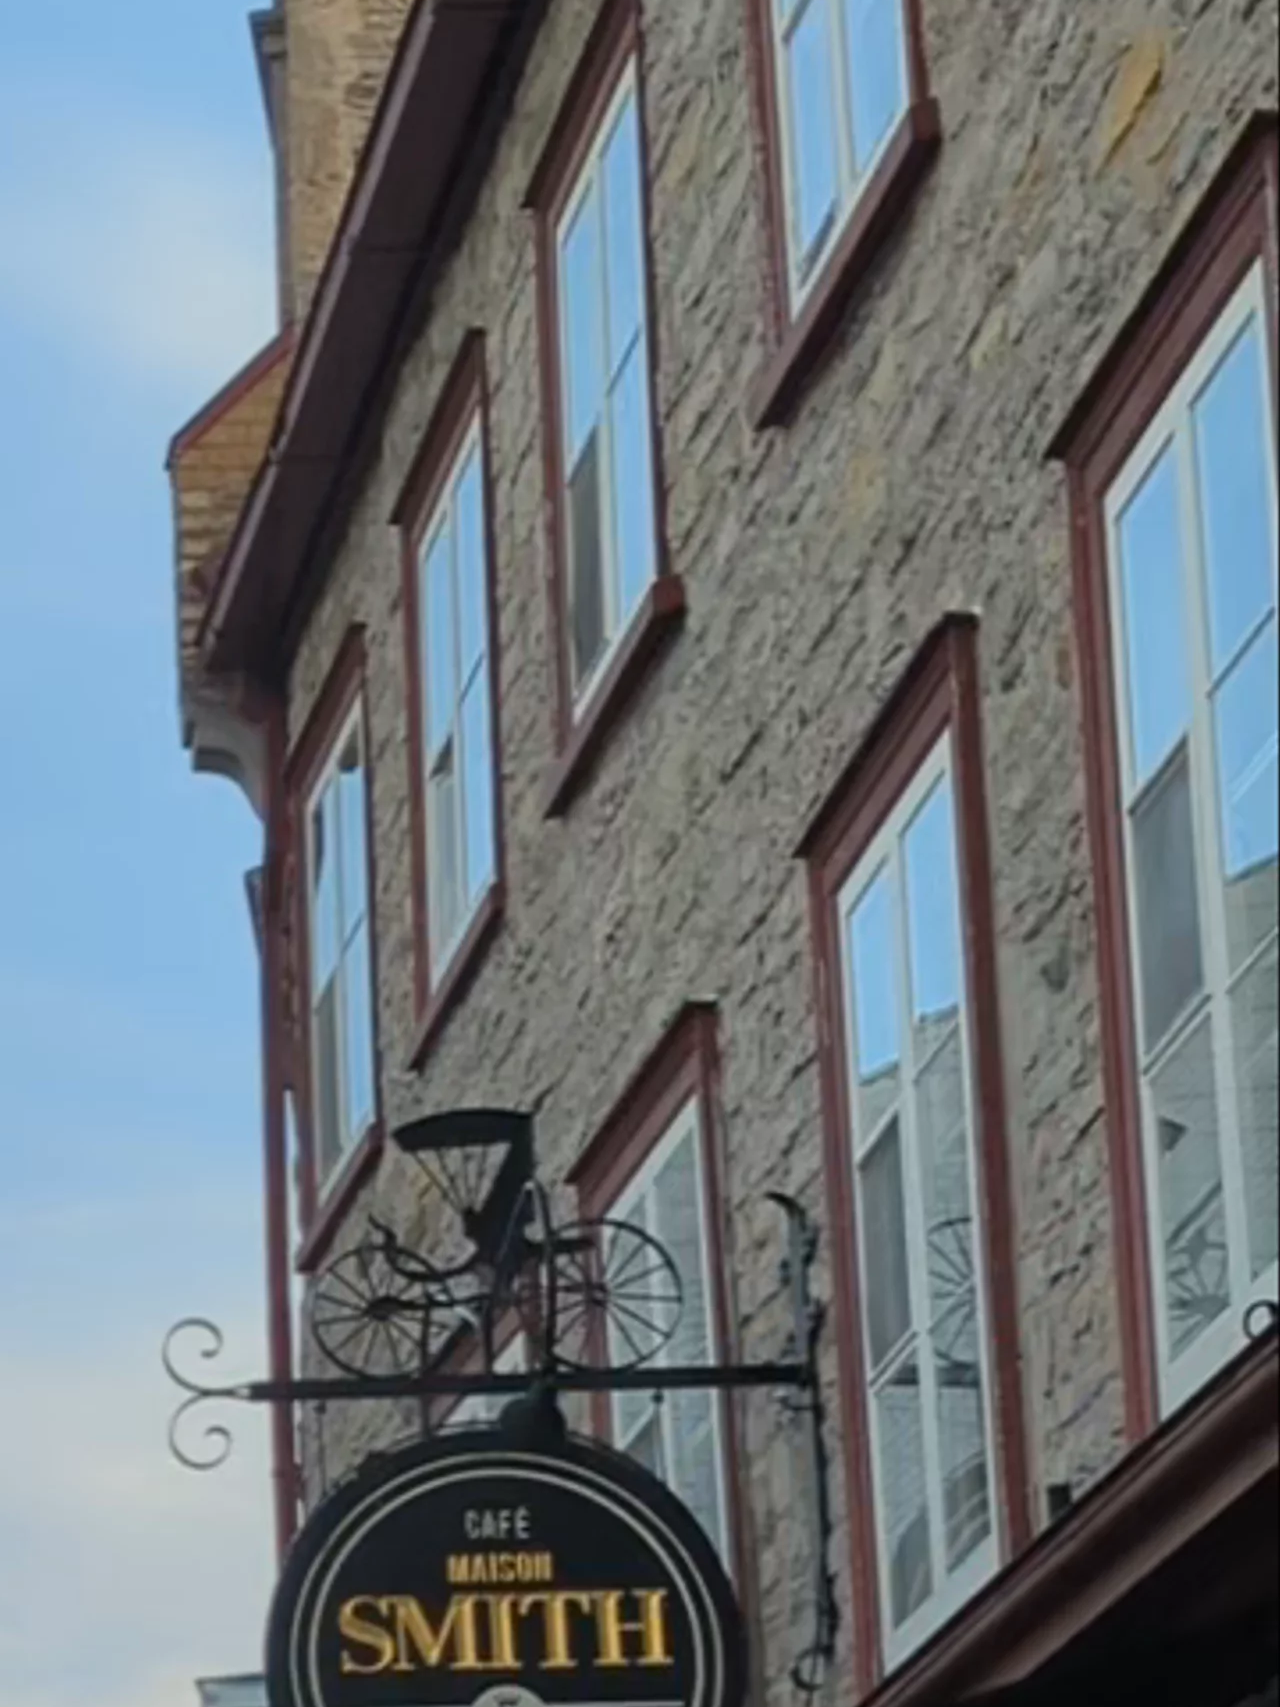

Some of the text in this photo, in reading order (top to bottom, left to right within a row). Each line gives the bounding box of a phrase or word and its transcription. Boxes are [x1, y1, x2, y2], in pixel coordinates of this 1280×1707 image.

[463, 1505, 531, 1540] CAFÉ
[447, 1550, 553, 1584] MAISON
[337, 1587, 675, 1674] SMITH
